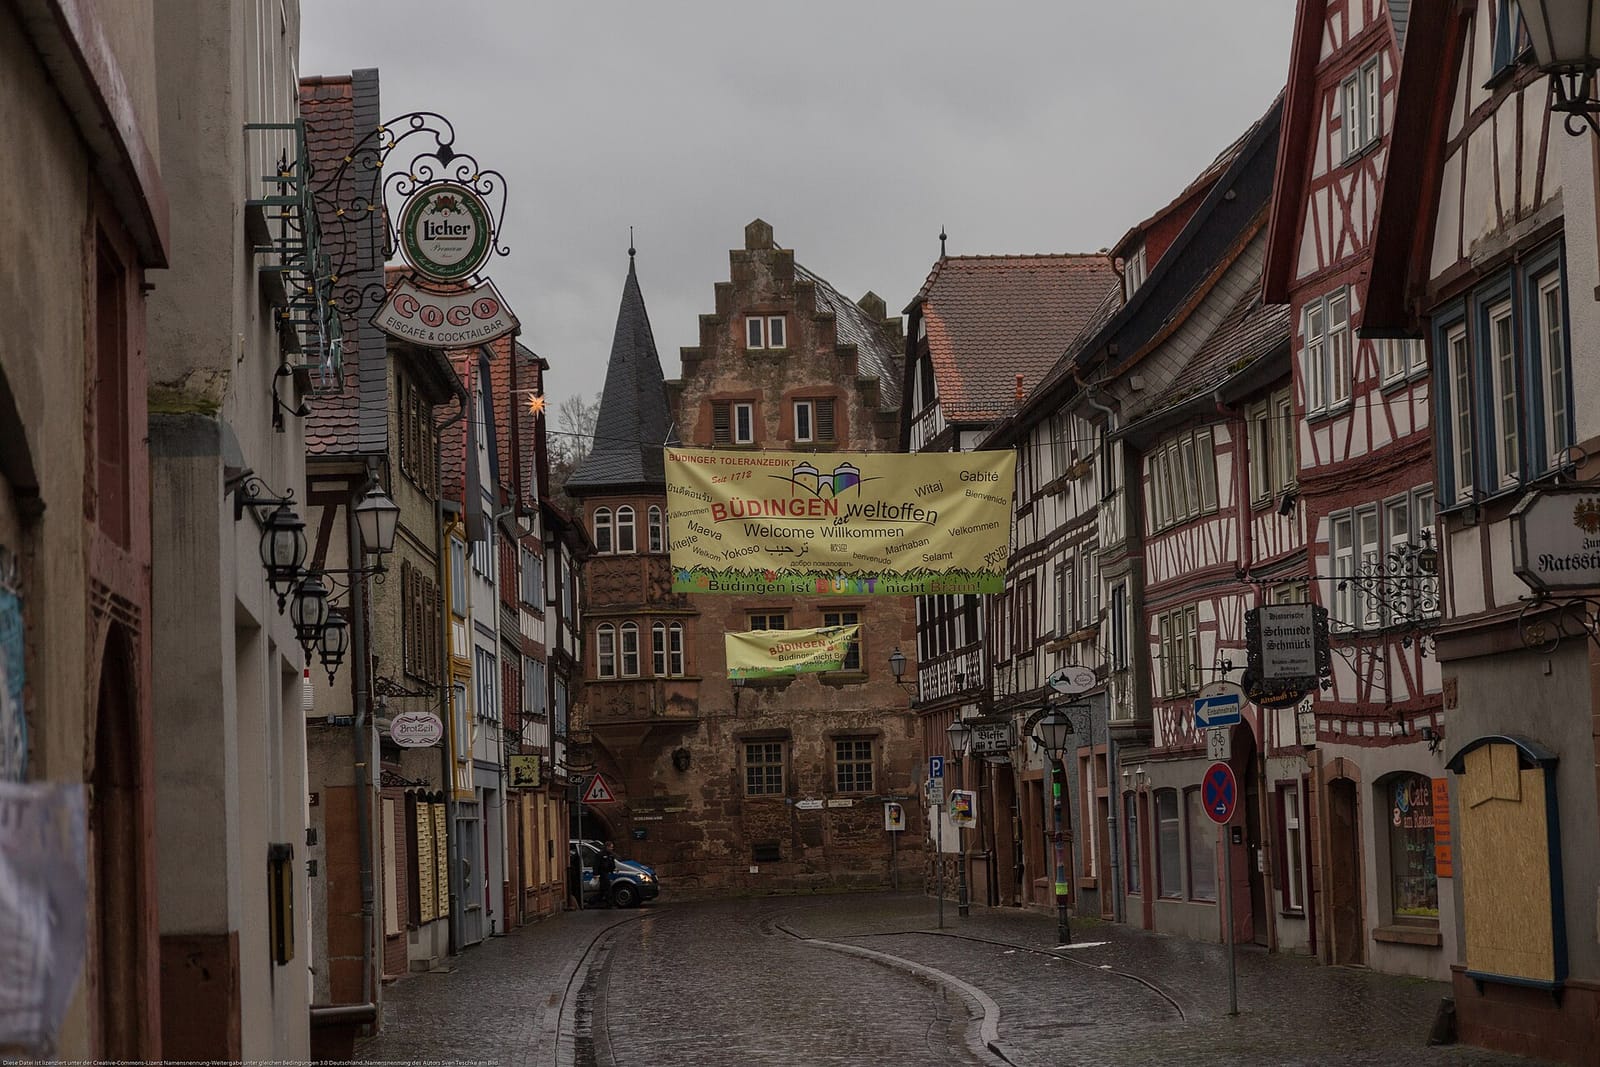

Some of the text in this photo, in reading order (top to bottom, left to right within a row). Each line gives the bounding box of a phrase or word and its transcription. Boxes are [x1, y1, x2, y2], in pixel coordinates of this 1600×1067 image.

[423, 219, 471, 241] Licher
[393, 293, 499, 328] COCO
[386, 316, 505, 342] EISCAFÉ & COCKTAILBAR
[720, 457, 796, 467] TOLERANZEDIKT
[711, 470, 753, 484] Seit 1712
[914, 480, 944, 498] Witaj
[965, 489, 1007, 506] Bienvenido
[711, 496, 838, 522] BÜDINGEN
[846, 500, 938, 524] weltoffen
[687, 519, 722, 541] Maeva
[743, 523, 904, 539] Welcome Willkommen
[948, 521, 1000, 537] Velkommen
[721, 544, 760, 561] Yokoso
[885, 537, 930, 555] Marhaban
[708, 580, 785, 594] Büdingen
[790, 582, 811, 593] ist
[885, 582, 925, 593] nicht
[930, 581, 980, 593] Braun!
[1263, 625, 1311, 637] Schmiede
[400, 724, 433, 733] BrotZeit
[932, 759, 941, 777] P
